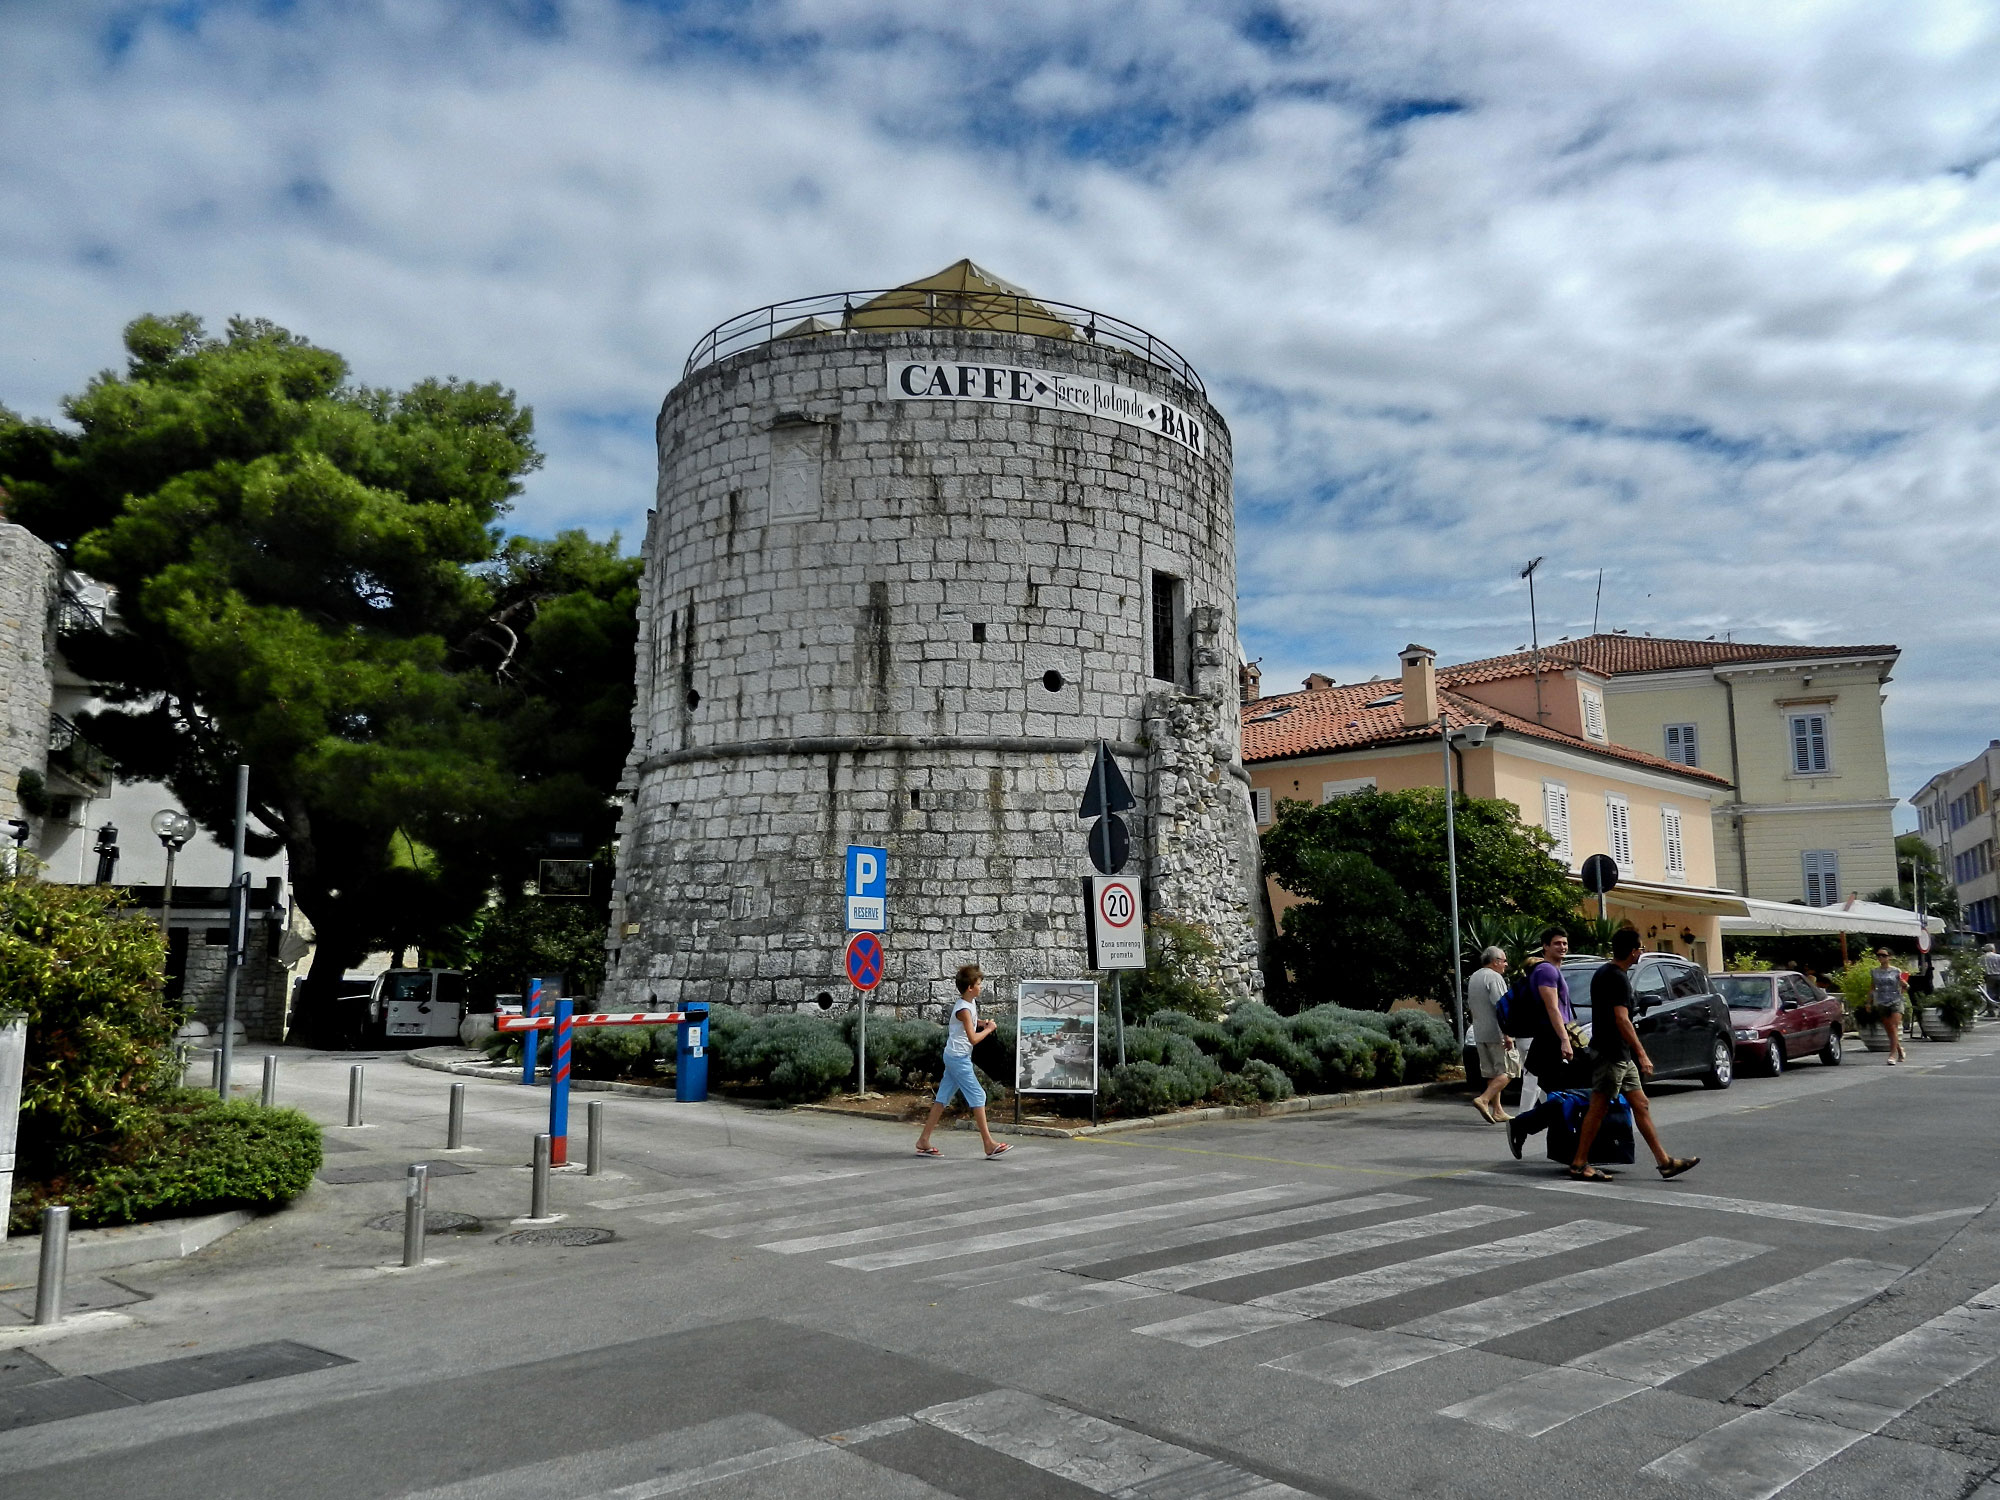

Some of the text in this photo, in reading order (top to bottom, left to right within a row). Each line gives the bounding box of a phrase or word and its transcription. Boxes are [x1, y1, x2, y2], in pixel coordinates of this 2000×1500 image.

[900, 363, 1035, 403] CAFFE
[1051, 374, 1090, 407] Torre
[1160, 403, 1201, 453] BAR
[856, 853, 877, 894] P
[853, 906, 879, 919] RESERVE
[1108, 894, 1129, 917] 20
[1101, 940, 1141, 949] Zona smirenog
[1110, 951, 1134, 961] prometa
